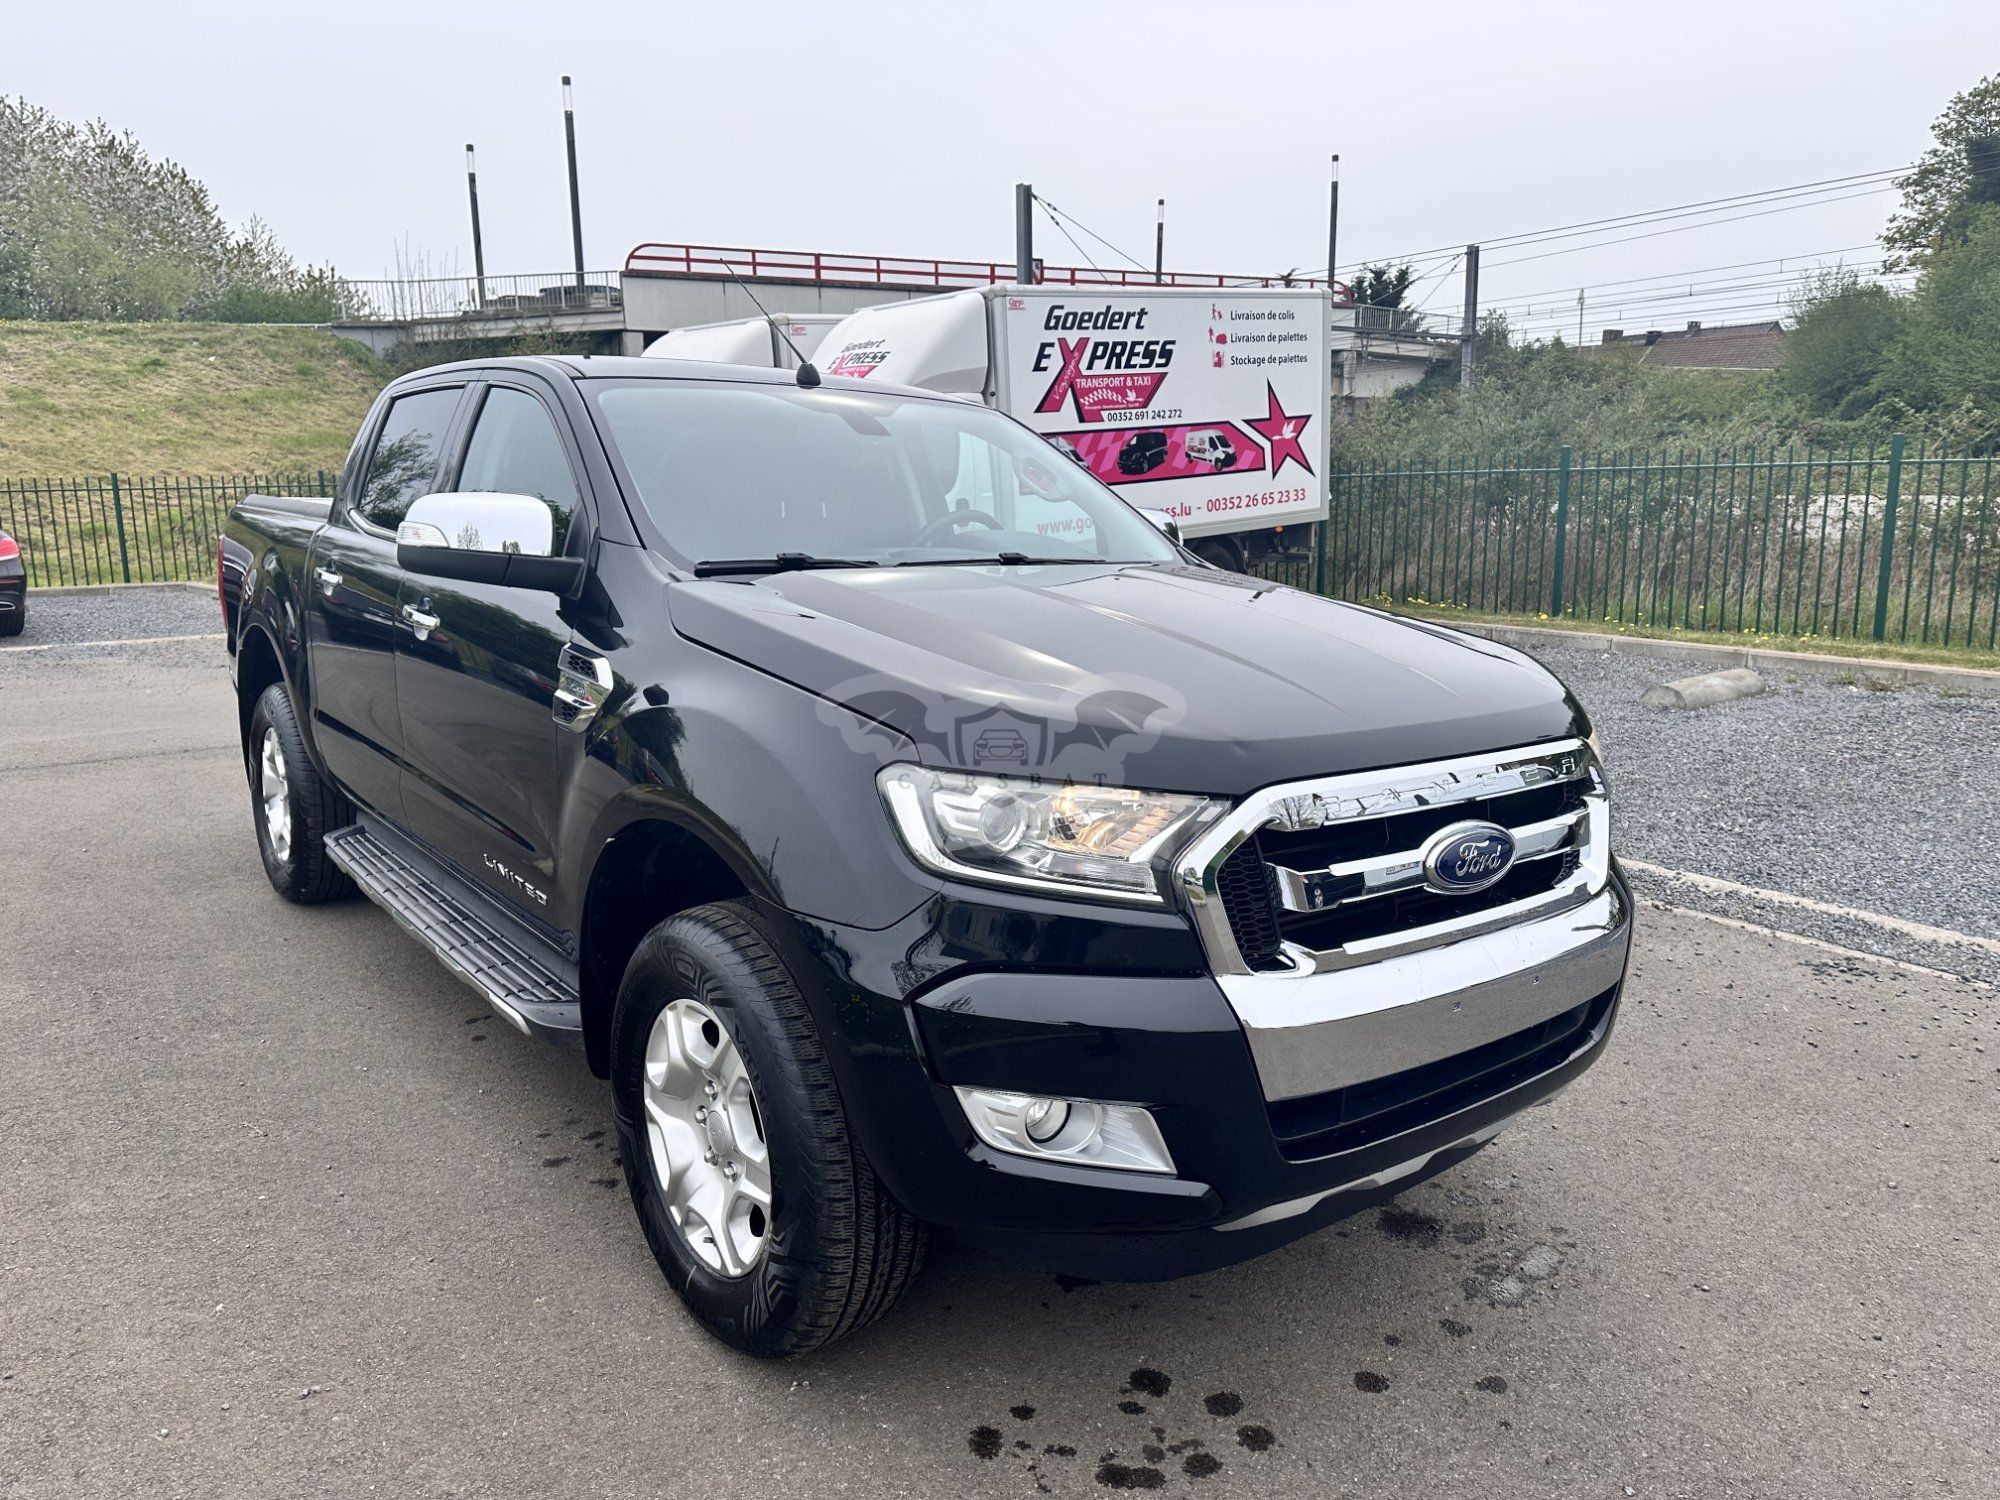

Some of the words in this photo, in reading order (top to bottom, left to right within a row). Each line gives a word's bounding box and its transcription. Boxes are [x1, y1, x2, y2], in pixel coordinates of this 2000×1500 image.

[1044, 305, 1148, 330] Goedert
[1230, 310, 1266, 321] Livraison
[1267, 310, 1277, 320] de
[1278, 309, 1295, 320] colis
[1230, 332, 1266, 343] Livraison
[1267, 332, 1277, 342] de
[1278, 331, 1308, 344] palettes
[1230, 354, 1266, 367] Stockage
[1267, 354, 1277, 364] de
[1278, 353, 1308, 366] palettes
[1075, 377, 1125, 389] TRANSPORT
[1125, 377, 1133, 387] &
[1134, 376, 1151, 387] TAXI
[1107, 411, 1133, 422] 00352
[1134, 410, 1149, 421] 691
[1152, 410, 1167, 420] 242
[1168, 409, 1183, 419] 272
[1206, 495, 1242, 513] 00352
[1244, 494, 1259, 508] 26
[1261, 492, 1275, 506] 65
[1277, 490, 1291, 504] 23
[1293, 488, 1307, 502] 33
[1455, 840, 1502, 877] Ford
[483, 853, 548, 906] LIMITED
